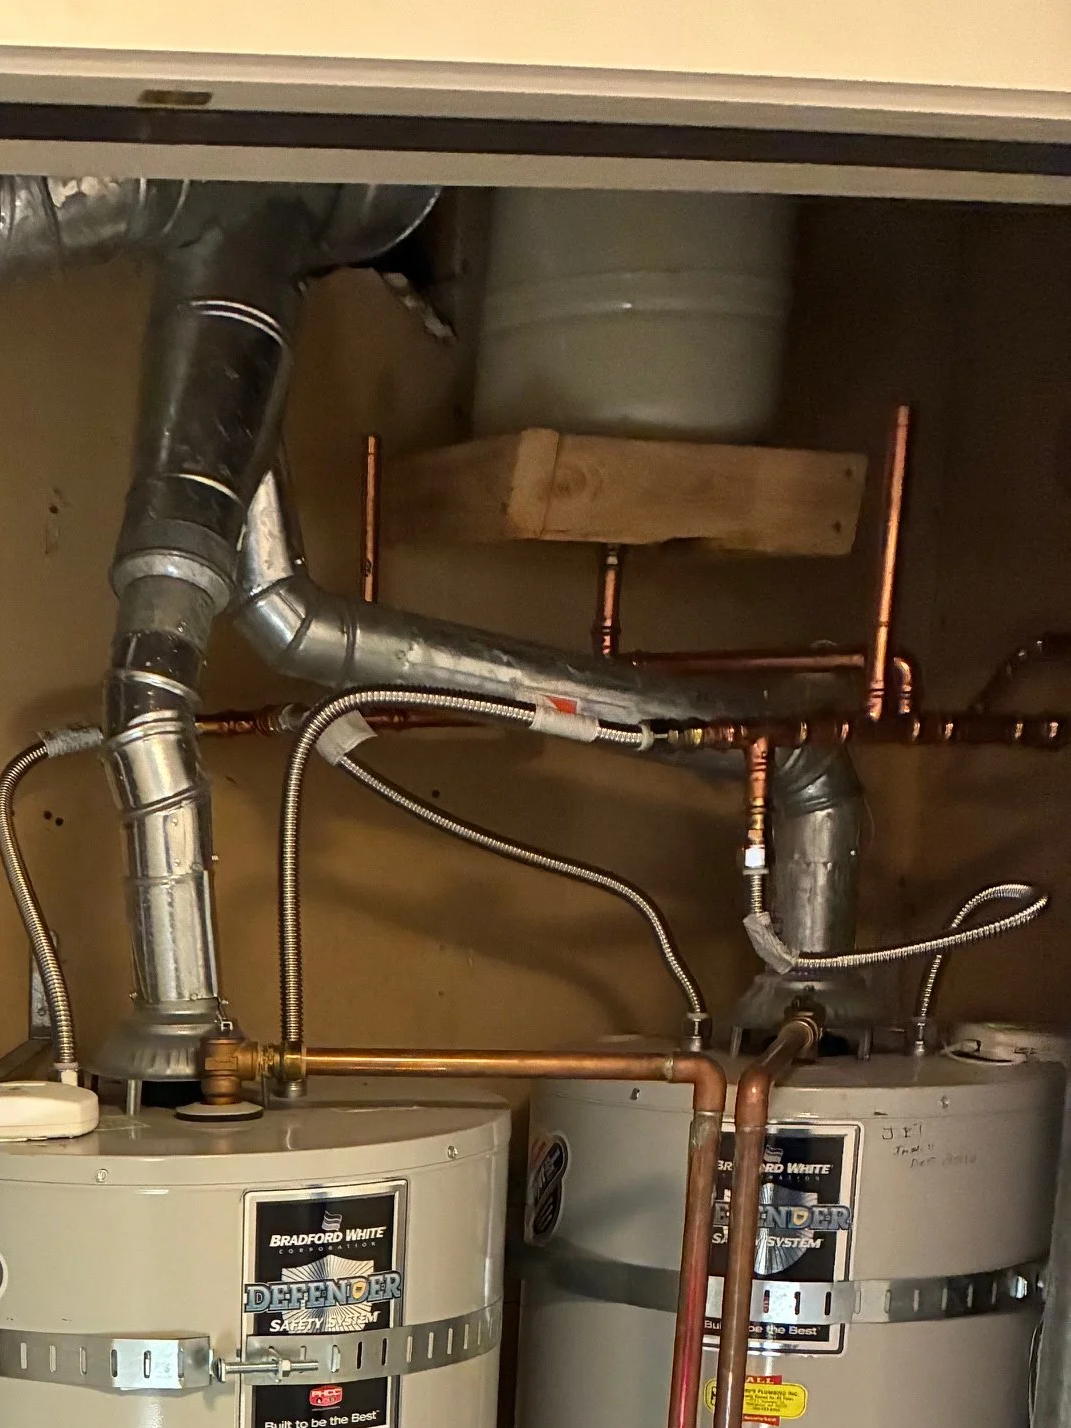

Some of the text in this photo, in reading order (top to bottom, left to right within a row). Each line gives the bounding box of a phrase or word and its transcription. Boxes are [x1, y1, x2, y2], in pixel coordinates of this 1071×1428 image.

[787, 1163, 830, 1175] WHITE
[269, 1226, 386, 1247] BRADFORD WHITE
[767, 1236, 823, 1249] SYSTEM
[279, 1241, 376, 1254] CORPORATION
[244, 1270, 402, 1312] DEFENDER
[269, 1310, 381, 1333] SAFETY SYSTEM
[766, 1325, 785, 1335] the
[788, 1326, 817, 1335] Best
[311, 1388, 342, 1398] PHCC
[295, 1420, 308, 1428] to
[311, 1418, 327, 1428] be
[329, 1415, 349, 1425] the
[351, 1411, 377, 1423] Best
